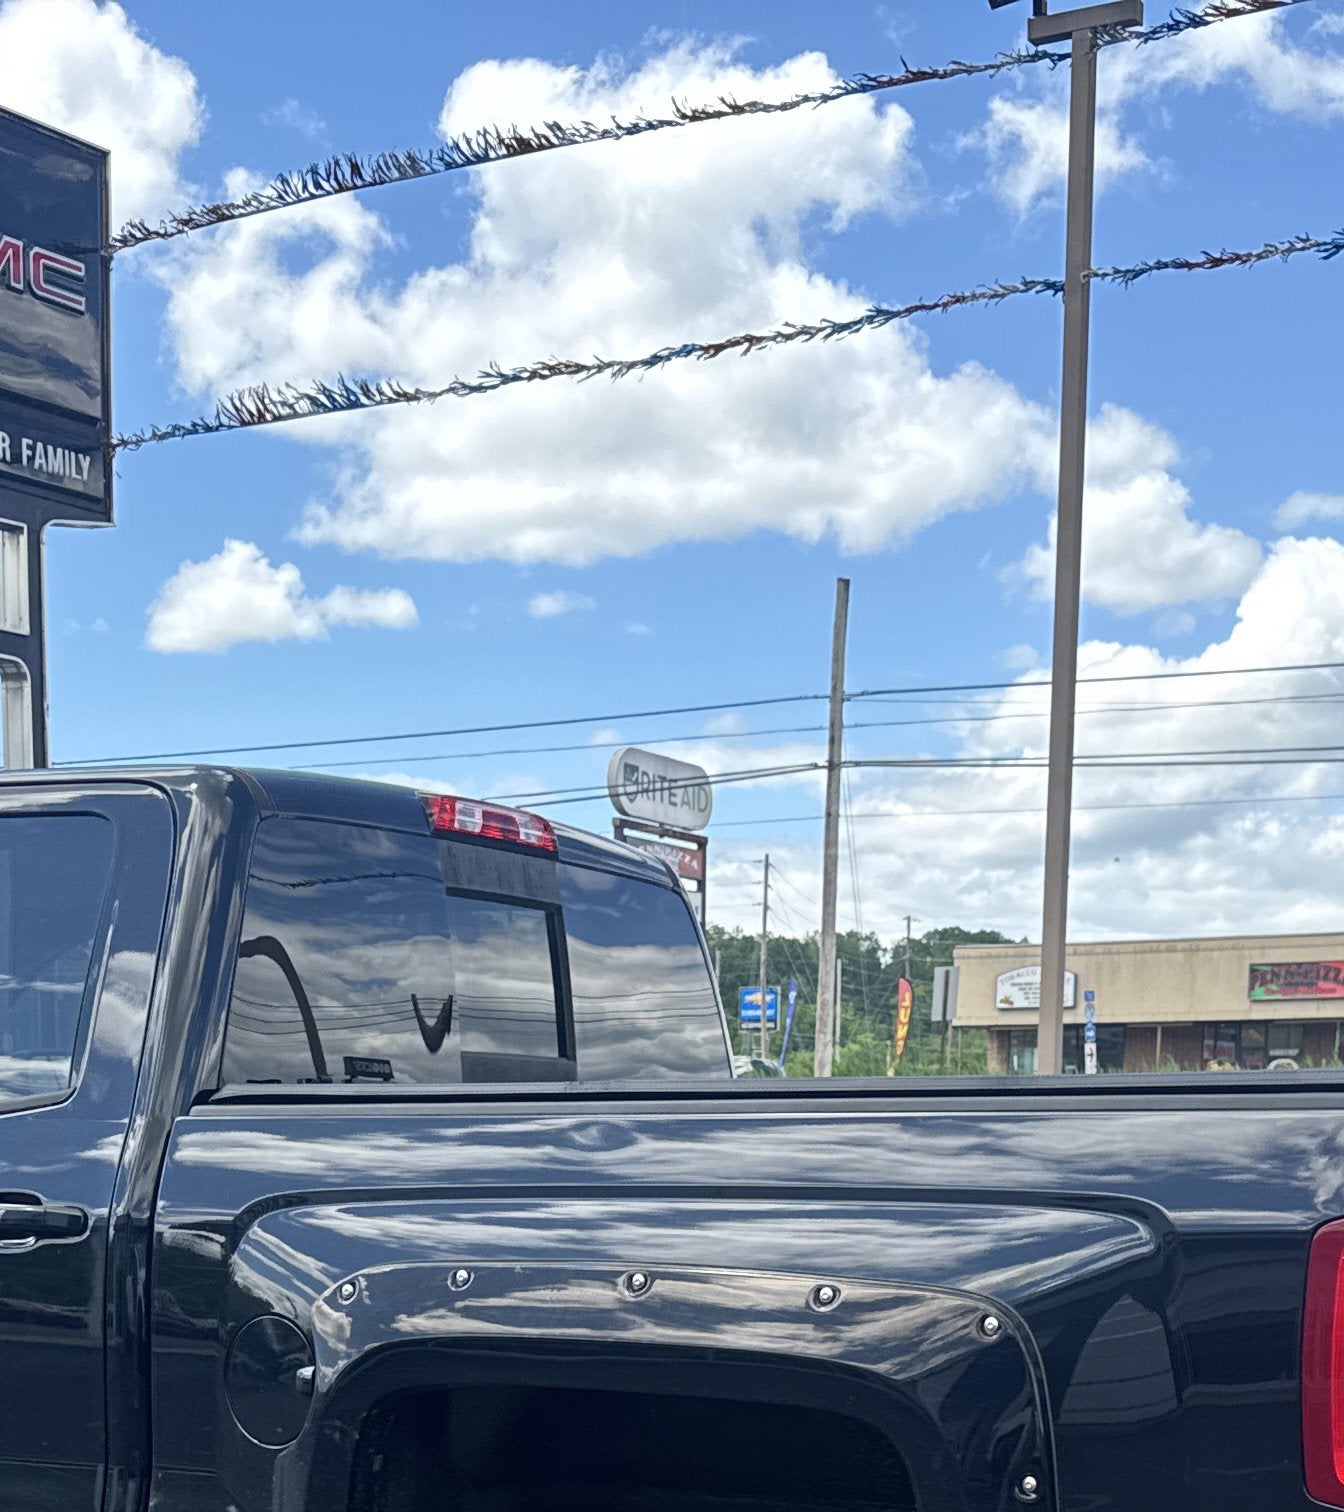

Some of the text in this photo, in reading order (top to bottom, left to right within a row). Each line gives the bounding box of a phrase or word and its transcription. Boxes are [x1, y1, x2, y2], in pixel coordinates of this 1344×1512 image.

[21, 437, 90, 481] FAMILY
[641, 769, 709, 813] RITE AID
